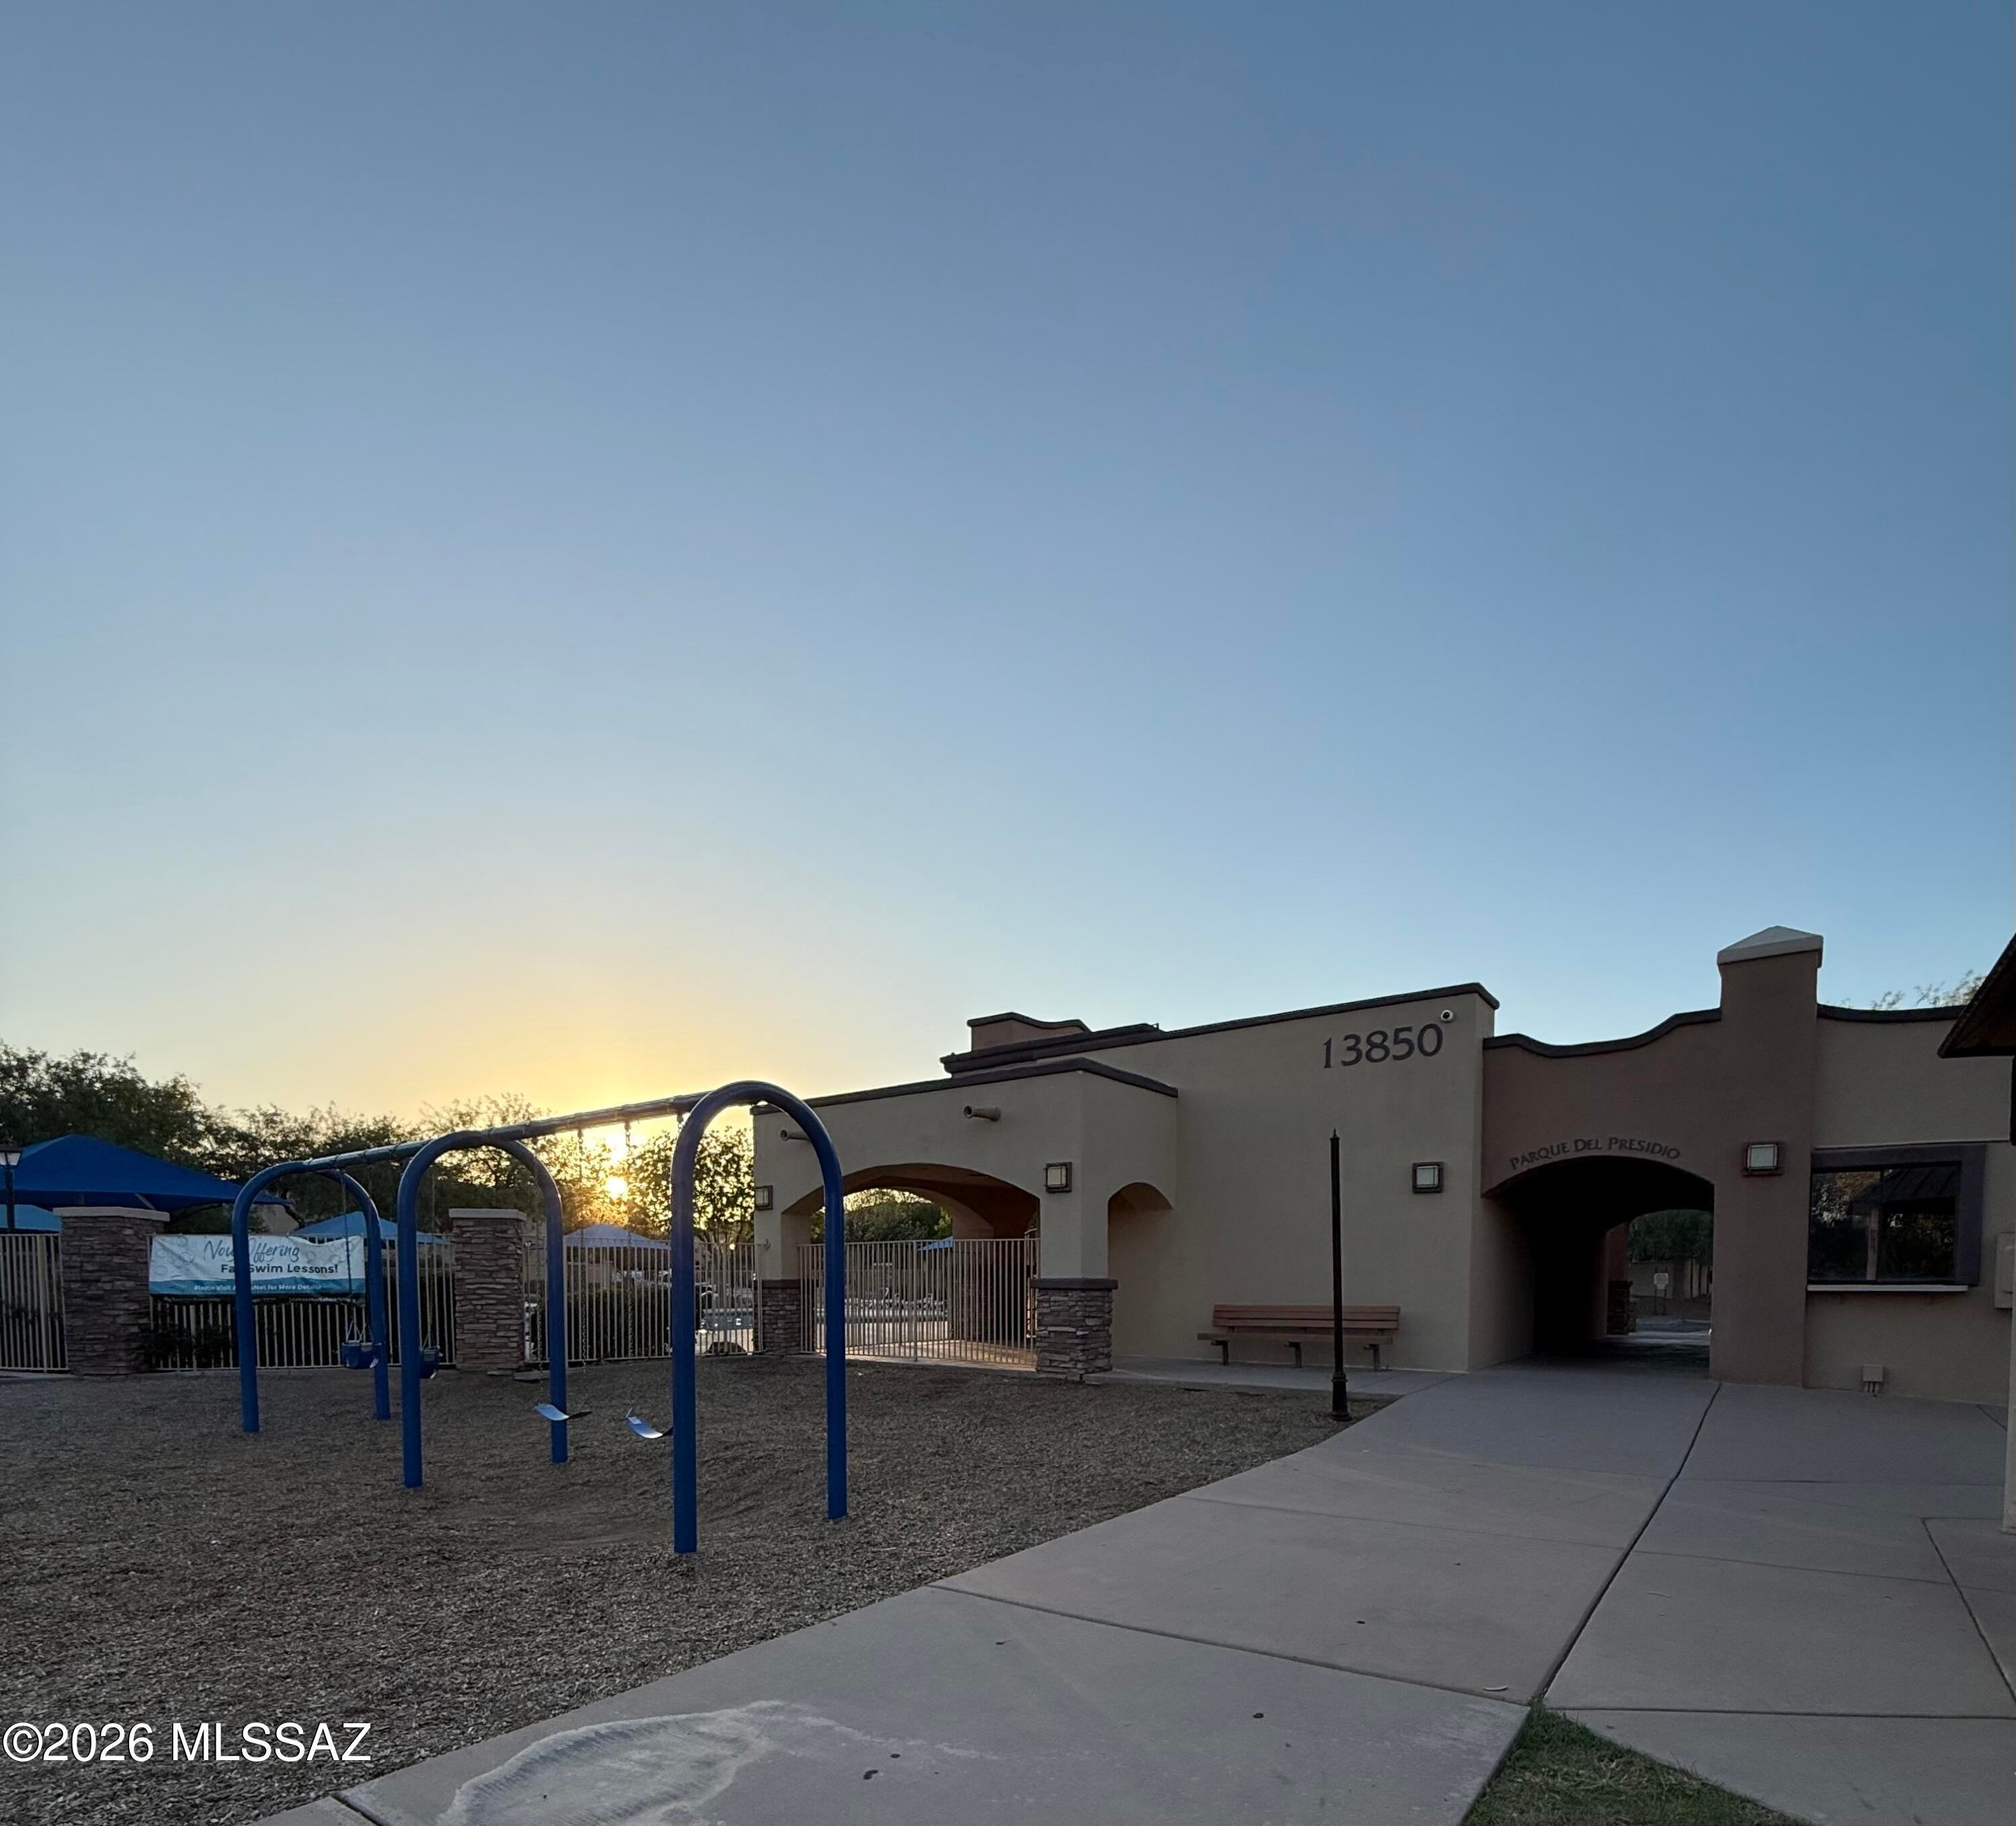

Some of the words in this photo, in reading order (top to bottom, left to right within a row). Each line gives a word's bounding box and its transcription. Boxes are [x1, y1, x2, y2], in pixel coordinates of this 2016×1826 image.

[1322, 1023, 1443, 1068] 13850
[1510, 1143, 1570, 1169] PARQUE
[1574, 1139, 1602, 1151] DEL
[1609, 1137, 1680, 1160] PRESIDIO
[221, 1264, 236, 1273] Fa
[248, 1264, 283, 1273] Swim
[287, 1264, 338, 1274] Lessons!
